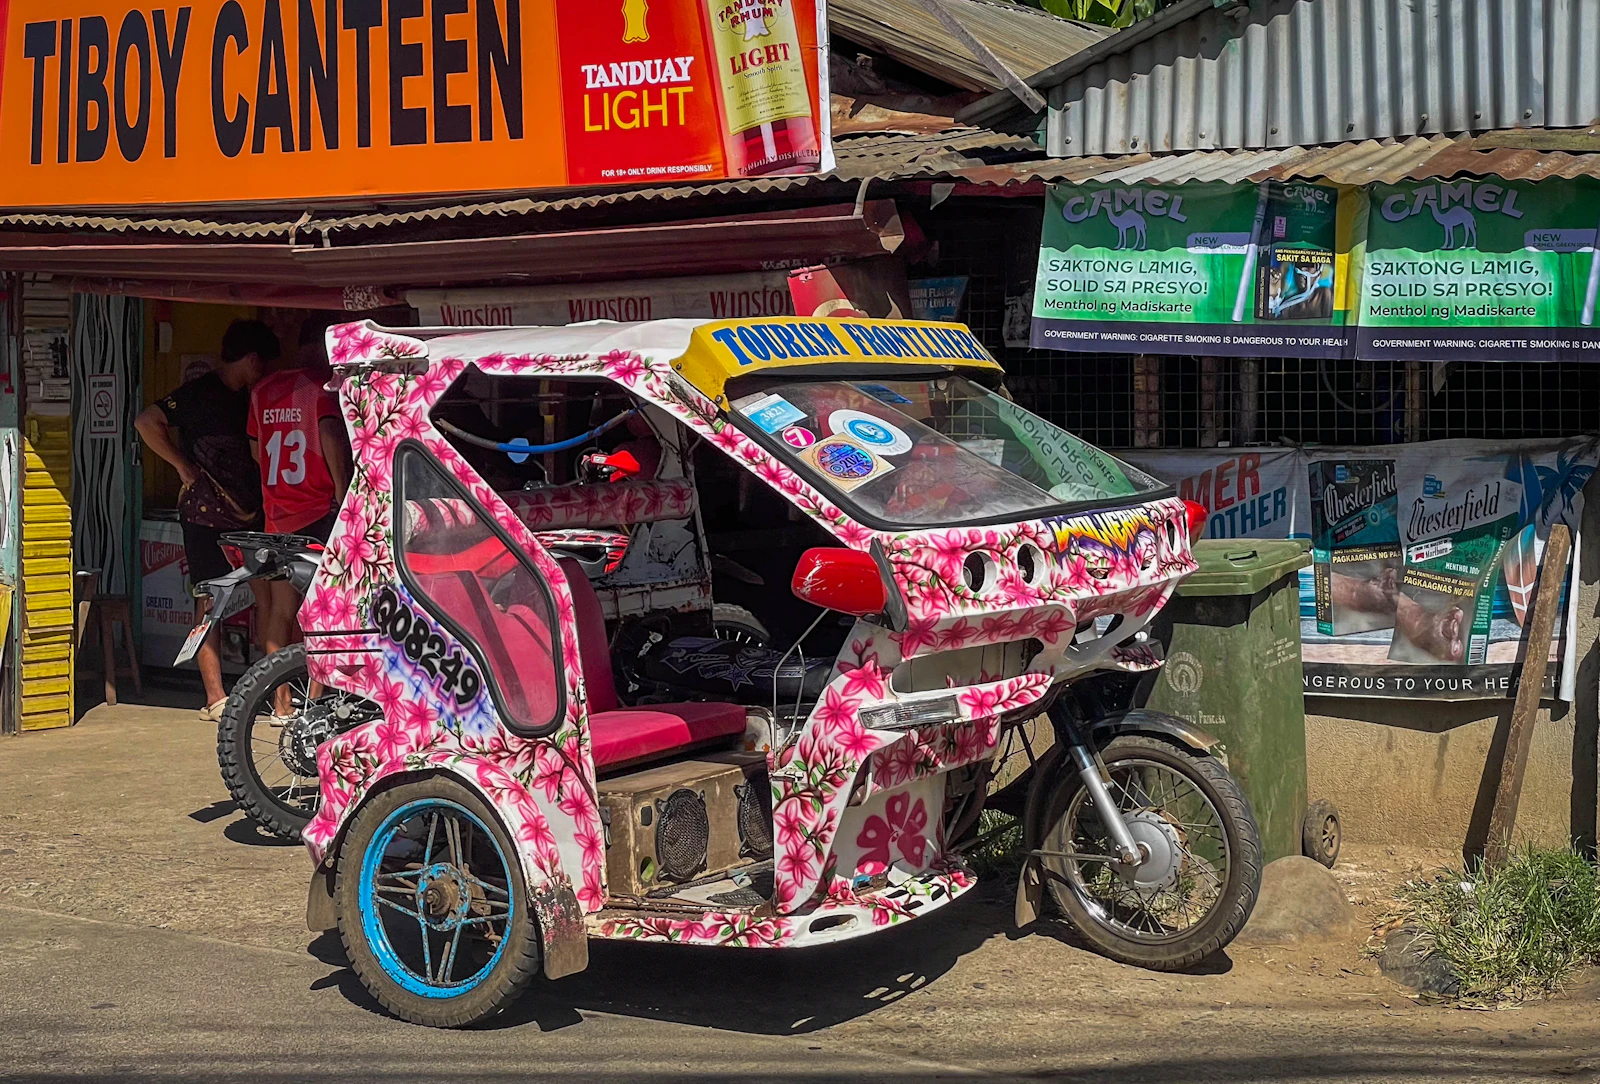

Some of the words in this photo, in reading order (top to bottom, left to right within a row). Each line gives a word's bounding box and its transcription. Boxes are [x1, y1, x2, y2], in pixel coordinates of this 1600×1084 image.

[730, 7, 773, 28] RHUM
[730, 42, 790, 76] LIGHT
[581, 56, 695, 89] TANDUAY
[744, 68, 766, 79] Smooth
[767, 64, 782, 74] Spirit
[24, 5, 193, 165] TIBOY
[210, 0, 524, 159] CANTEEN
[583, 86, 694, 132] LIGHT
[601, 169, 615, 177] FOR
[627, 167, 646, 176] ONLY.
[646, 166, 667, 175] DRINK
[667, 164, 713, 174] RESPONSIBLY.
[1283, 186, 1330, 204] CAMEL
[1380, 182, 1524, 222] CAMEL
[1061, 187, 1188, 224] CAMEL
[1194, 236, 1218, 245] NEW
[1533, 233, 1561, 242] NEW
[1276, 253, 1299, 262] SAKIT
[1300, 255, 1311, 263] SA
[1311, 256, 1331, 264] BAGA
[1049, 259, 1133, 274] SAKTONG
[1139, 260, 1198, 277] LAMIG,
[1370, 260, 1464, 277] SAKTONG
[1471, 260, 1540, 277] LAMIG,
[1047, 279, 1099, 294] SOLID
[1103, 279, 1126, 294] SA
[1132, 280, 1208, 296] PRESYO!
[1370, 283, 1427, 298] SOLID
[1433, 283, 1459, 297] SA
[1466, 282, 1553, 298] PRESYO!
[440, 304, 513, 326] Winston
[568, 296, 653, 323] Winston
[1044, 298, 1098, 312] Menthol
[1101, 302, 1117, 315] ng
[1120, 300, 1192, 314] Madiskarte
[1370, 304, 1427, 317] Menthol
[1431, 307, 1449, 319] ng
[1454, 304, 1536, 317] Madiskarte
[711, 322, 850, 367] TOURISM
[840, 322, 995, 362] FRONTLINER
[1044, 330, 1099, 340] GOVERNMENT
[1100, 332, 1138, 342] WARNING:
[1139, 333, 1183, 343] CIGARETTE
[1184, 334, 1221, 344] SMOKING
[1223, 335, 1231, 344] IS
[1232, 336, 1283, 345] DANGEROUS
[1285, 336, 1297, 345] TO
[1298, 337, 1321, 346] YOUR
[1372, 339, 1431, 348] GOVERNMENT
[1433, 339, 1477, 348] WARNING:
[1478, 339, 1528, 348] CIGARETTE
[1529, 340, 1570, 349] SMOKING
[1572, 340, 1580, 349] IS
[263, 408, 302, 424] ESTARES
[760, 405, 787, 421] 3821
[785, 428, 808, 446] 7
[265, 429, 307, 486] 13
[839, 452, 868, 469] 2024
[1173, 453, 1261, 514] MER
[1209, 486, 1287, 539] OTHER
[1407, 481, 1500, 542] Chesterfield
[1049, 507, 1156, 553] WOLVERINE
[1332, 552, 1377, 564] PAGKAAGNAS
[1378, 551, 1388, 559] NG
[1389, 550, 1402, 558] PAA
[1425, 547, 1448, 559] Marlboro
[1445, 562, 1469, 573] MENTHOL
[1403, 575, 1452, 594] PAGKAAGNAS
[1453, 586, 1463, 596] NG
[1462, 588, 1474, 598] PAA
[146, 596, 173, 609] CREATED
[156, 609, 169, 621] NO
[169, 610, 193, 626] OTHER
[1394, 678, 1416, 691] TO
[1423, 678, 1474, 691] YOUR
